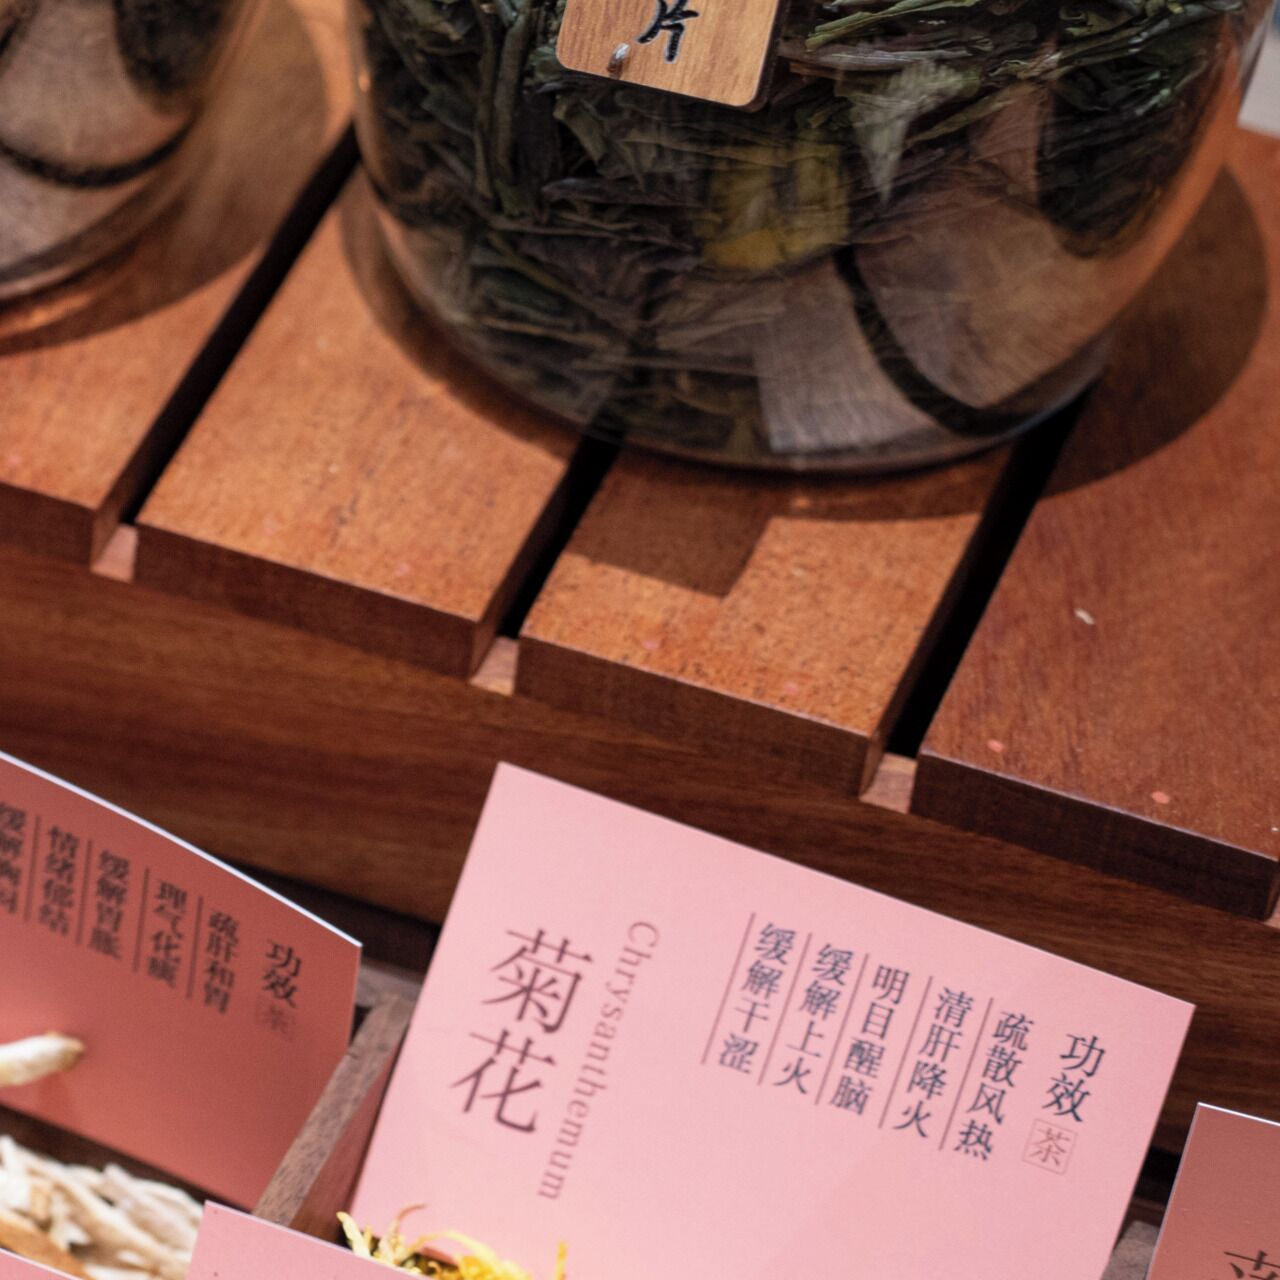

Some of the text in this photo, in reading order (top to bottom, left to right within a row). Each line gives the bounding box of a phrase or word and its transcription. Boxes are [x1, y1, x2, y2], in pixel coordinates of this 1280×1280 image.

[87, 848, 131, 963] 缓解胃胀
[146, 879, 188, 990] 理气化痰
[201, 908, 241, 1016] 疏肝和胃
[259, 937, 302, 1010] 功效
[449, 927, 593, 1136] 菊花
[535, 920, 660, 1202] Chrysanthemum
[716, 922, 799, 1077] 缓解干涩
[770, 941, 857, 1096] 缓解上火
[830, 962, 911, 1117] 明目醒脑
[892, 985, 974, 1140] 清肝降火
[954, 1007, 1036, 1164] 疏散风热
[1042, 1033, 1105, 1124] 功效
